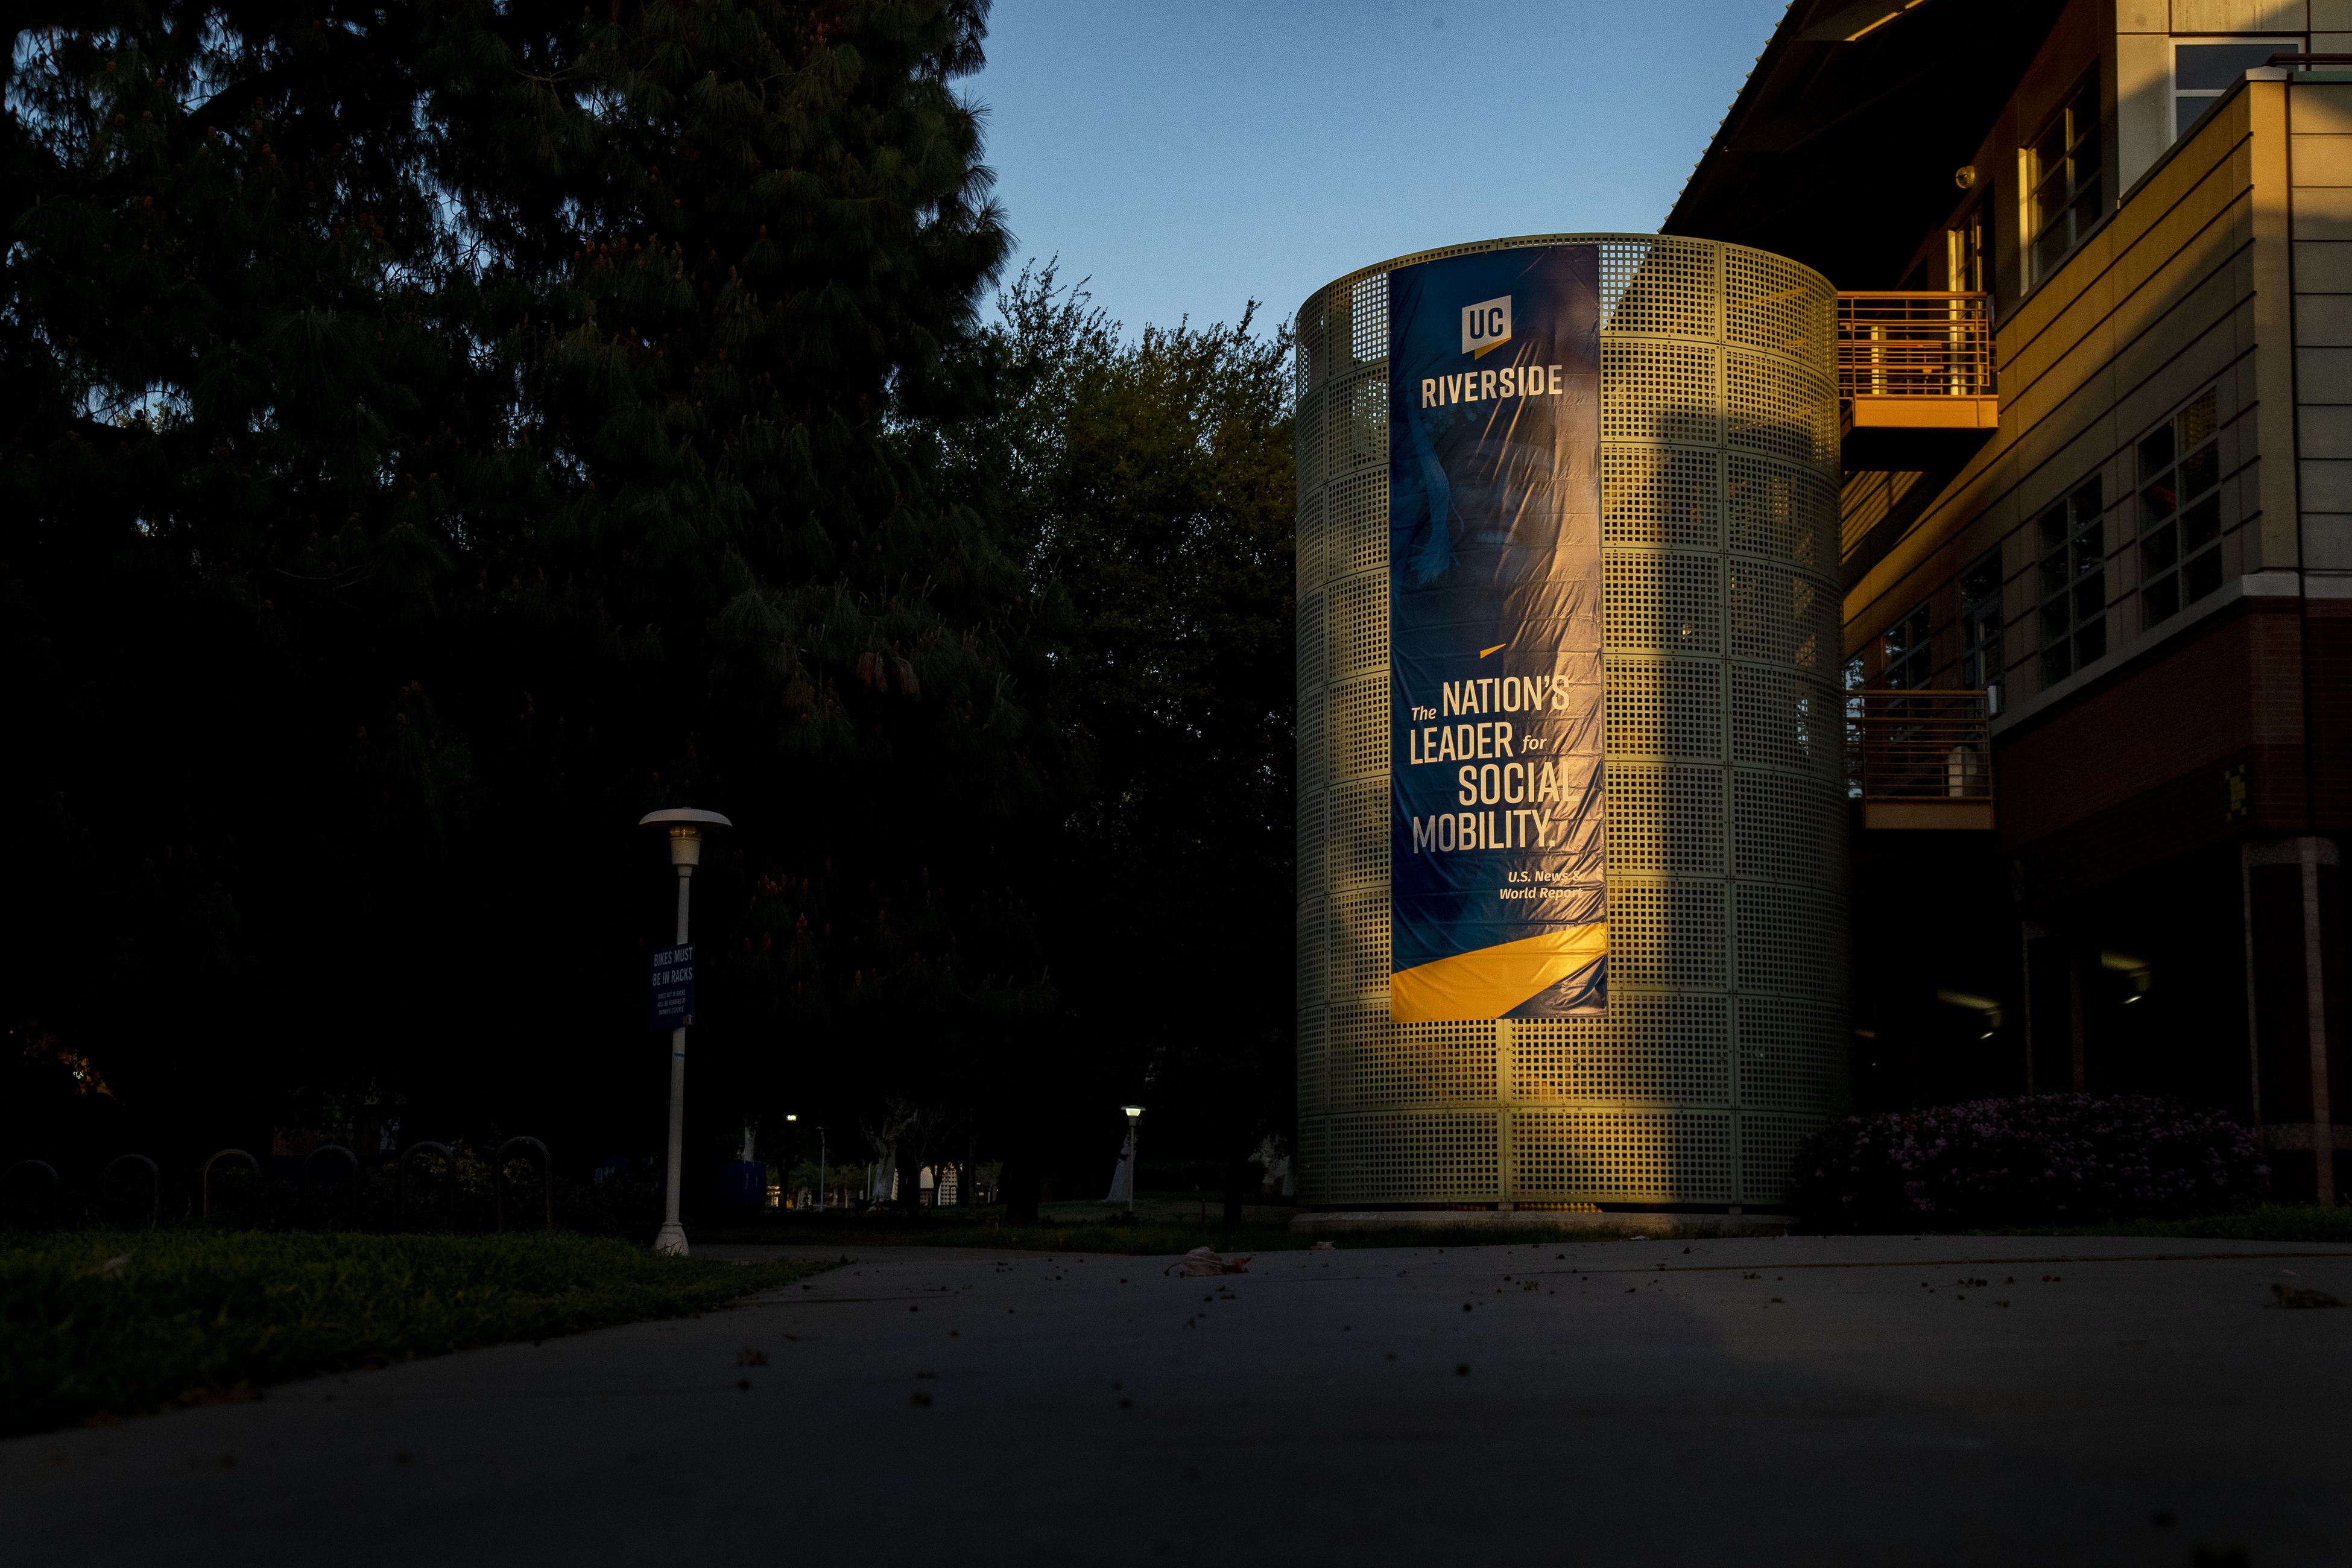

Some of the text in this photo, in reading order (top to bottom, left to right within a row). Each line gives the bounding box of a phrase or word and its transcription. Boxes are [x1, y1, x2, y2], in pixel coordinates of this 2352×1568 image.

[1470, 308, 1503, 340] UC
[1422, 364, 1563, 409] RIVERSIDE
[1411, 675, 1569, 721] The NATION'S
[1410, 721, 1547, 765] LEADER for
[1459, 761, 1579, 806] SOCIAL
[1413, 809, 1555, 854] MOBILITY.
[1500, 887, 1583, 900] World Report
[1508, 870, 1581, 882] U.S. News &
[654, 947, 694, 967] BIKES MUST
[653, 967, 693, 987] BE IN RACKS
